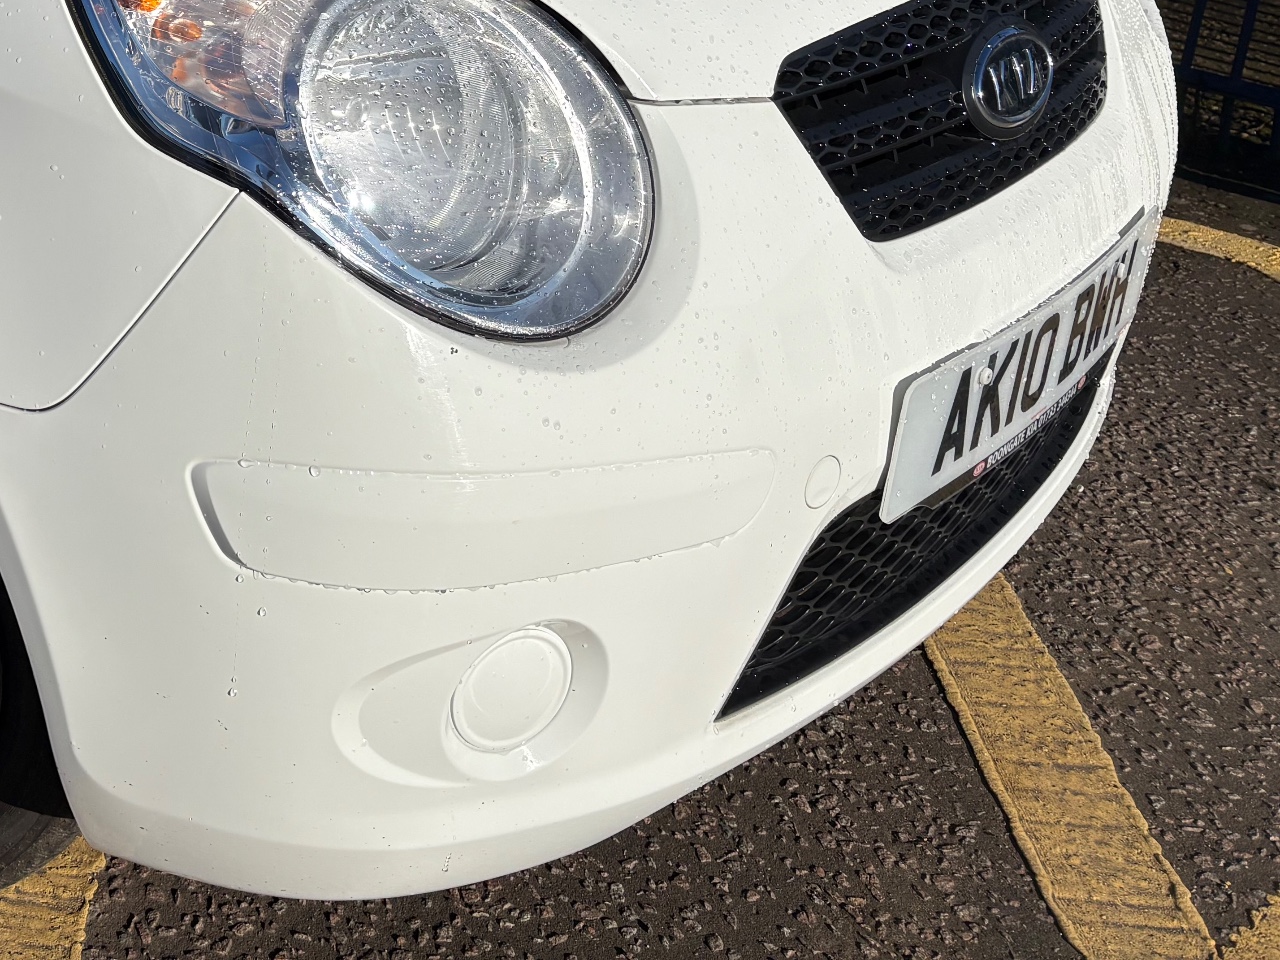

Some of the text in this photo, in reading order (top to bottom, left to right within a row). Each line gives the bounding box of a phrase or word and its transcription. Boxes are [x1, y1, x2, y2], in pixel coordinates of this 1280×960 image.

[930, 237, 1139, 478] AK10 BWH
[986, 429, 1027, 469] BOONGATE
